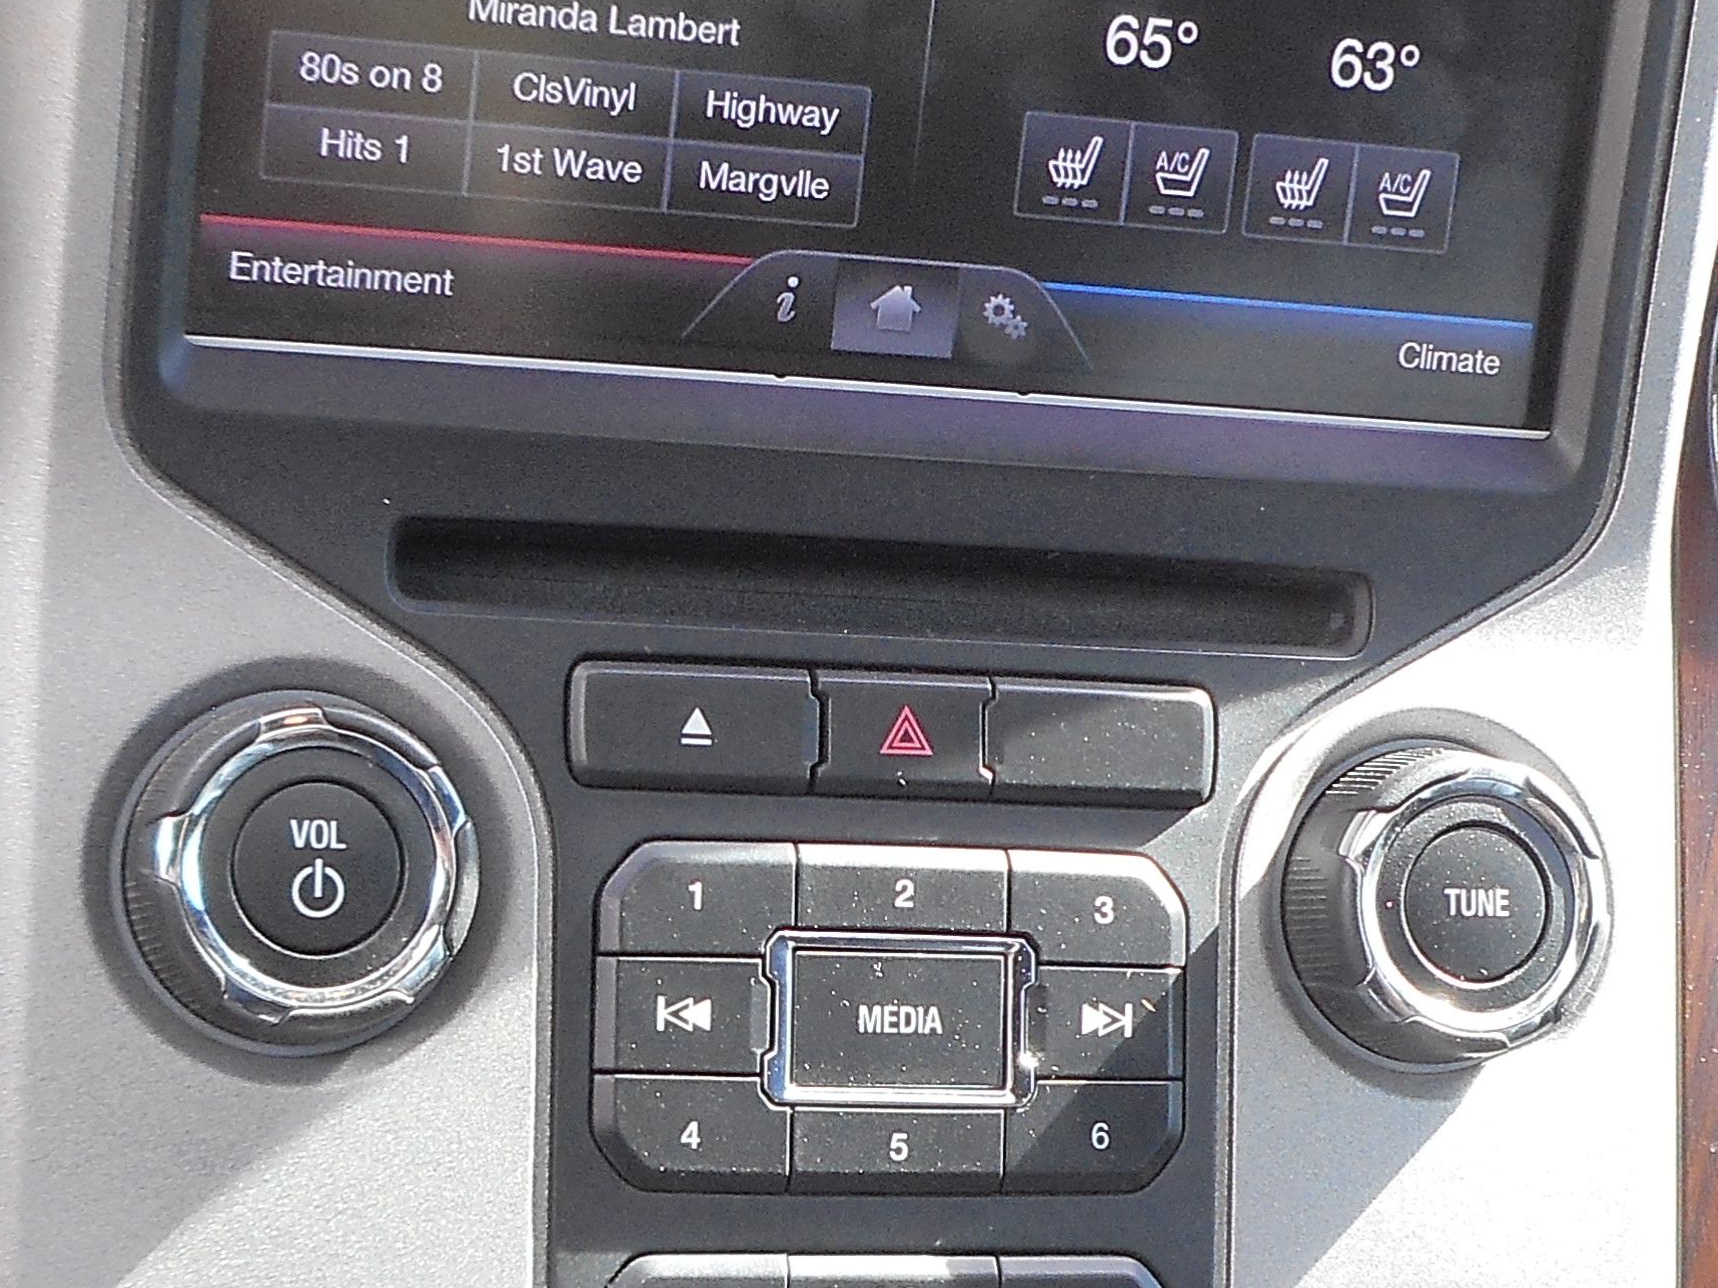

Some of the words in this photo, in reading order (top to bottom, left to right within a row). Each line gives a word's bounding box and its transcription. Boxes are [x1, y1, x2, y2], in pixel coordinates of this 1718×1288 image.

[608, 4, 741, 47] Lambert
[1106, 13, 1199, 69] 65°
[299, 51, 360, 85] 80s
[369, 65, 412, 91] on
[421, 62, 443, 93] 8
[1331, 37, 1420, 92] 63°
[513, 71, 636, 116] ClsVinyl
[706, 89, 840, 135] Highway
[320, 127, 382, 161] Hits
[394, 134, 409, 163] 1
[1156, 150, 1191, 172] A/C
[496, 143, 544, 175] 1st
[552, 147, 643, 183] Wave
[699, 160, 830, 202] Margvlle
[1379, 171, 1415, 193] A/C
[229, 250, 455, 296] Entertainment
[1398, 341, 1501, 375] Climate
[289, 818, 347, 849] VOL
[688, 881, 703, 910] 1
[894, 878, 915, 908] 2
[1093, 895, 1115, 925] 3
[1443, 888, 1511, 918] TUNE
[857, 999, 943, 1035] MEDIA
[680, 1120, 701, 1150] 4
[889, 1132, 909, 1162] 5
[1091, 1122, 1110, 1150] 6
